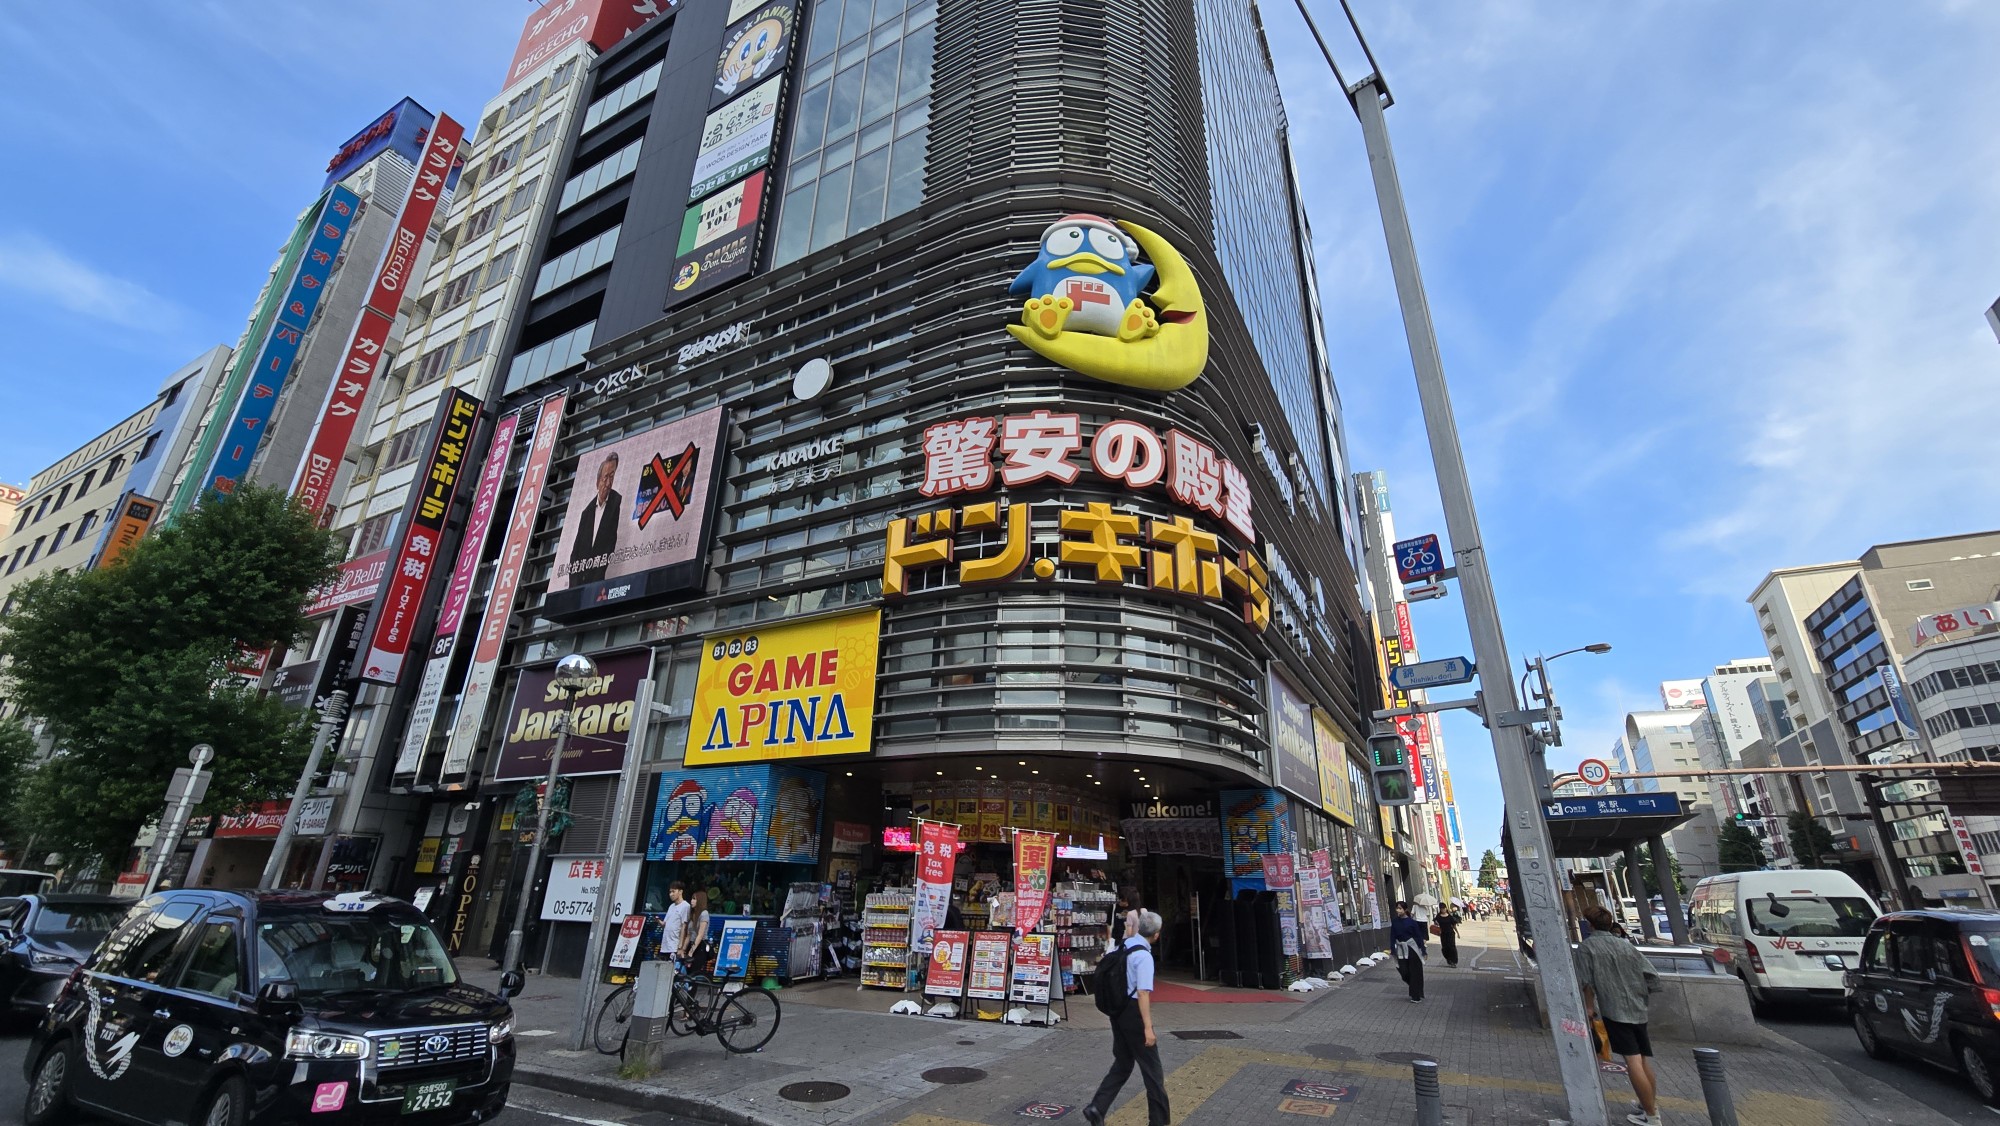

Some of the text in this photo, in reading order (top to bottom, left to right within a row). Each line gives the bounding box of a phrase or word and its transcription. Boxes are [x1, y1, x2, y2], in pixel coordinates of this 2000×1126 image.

[514, 51, 543, 78] BIG
[546, 15, 588, 53] ECHO
[705, 132, 768, 169] WOOD DESIGN PARK
[415, 136, 454, 201] カラオケ
[698, 194, 742, 224] THANK
[706, 210, 731, 230] YOU
[381, 227, 415, 291] BIG ECHO
[331, 337, 381, 418] カラオケ
[594, 365, 645, 394] ORCA
[536, 410, 558, 452] 免税
[420, 397, 475, 520] ドン・キホーテ
[766, 435, 843, 472] KARAOKE
[308, 453, 331, 483] BIG
[919, 410, 1256, 545] 驚安の殿堂
[515, 463, 543, 530] TAX
[443, 427, 510, 629] 表参道スキンクリニック
[403, 534, 432, 580] 免税
[881, 500, 1271, 633] ドン・キホーテ
[353, 563, 376, 587] Bell
[397, 585, 412, 610] Tax
[486, 542, 520, 642] FREE
[388, 611, 404, 643] Free
[1932, 607, 1995, 633] あい
[434, 637, 453, 655] 8F
[714, 640, 757, 657] B1 B2 B3
[273, 671, 289, 688] 2F
[727, 649, 839, 697] GAME
[1403, 661, 1457, 679] 錦通
[1411, 673, 1452, 684] Nishiki-dori
[1281, 691, 1304, 729] Super
[1424, 766, 1437, 800] マッサージ
[1585, 765, 1603, 779] 50
[300, 800, 331, 816] ダーツバー
[1131, 801, 1212, 819] Welcome!
[1597, 800, 1619, 809] 栄駅
[1650, 799, 1657, 808] 1
[257, 815, 271, 828] BIG
[923, 840, 952, 858] 免税
[328, 864, 369, 874] ダーツバー
[568, 860, 606, 879] 広告募
[925, 867, 944, 877] Free
[928, 858, 943, 868] Tax
[1018, 890, 1045, 899] Medical
[338, 903, 365, 911] つばめ
[448, 875, 477, 951] OPEN
[626, 919, 639, 930] 免税
[1769, 935, 1806, 951] WEX
[100, 1028, 116, 1042] TAXI
[418, 1082, 447, 1095] 名古屋500
[412, 1090, 453, 1112] 24-52
